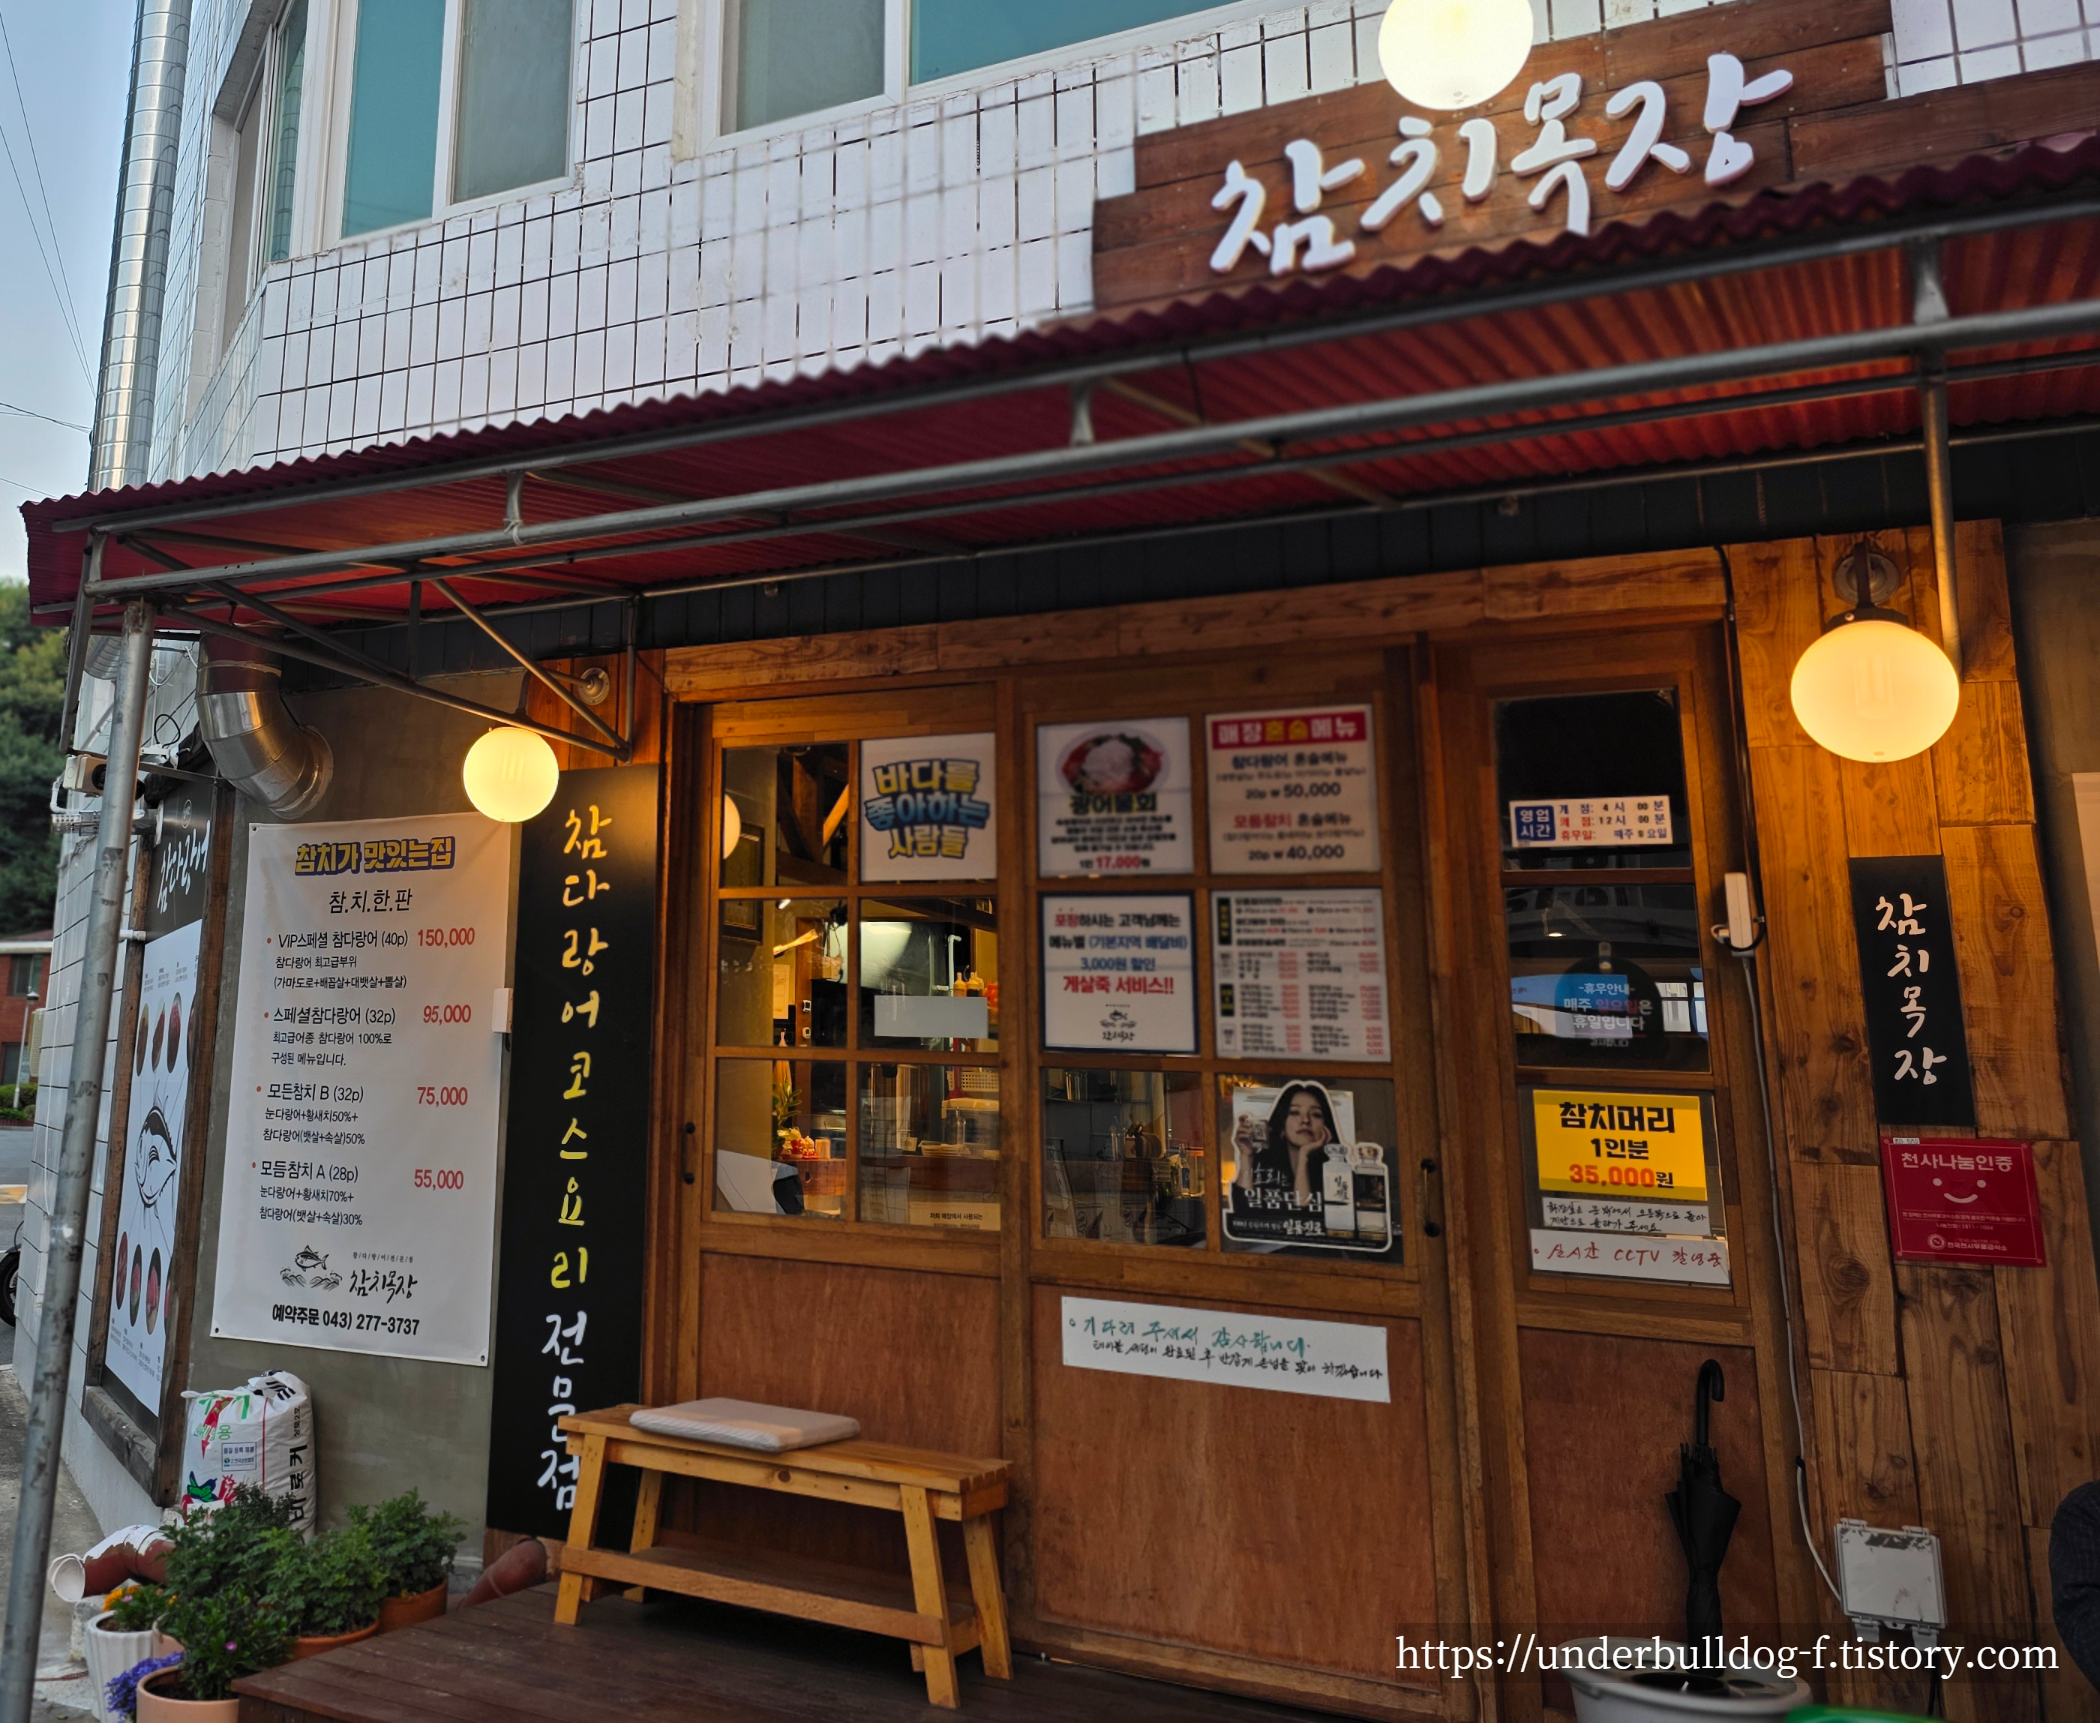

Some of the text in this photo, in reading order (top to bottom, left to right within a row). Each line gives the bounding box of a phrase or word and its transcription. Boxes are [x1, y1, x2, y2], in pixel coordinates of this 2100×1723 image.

[1210, 52, 1793, 276] 참치목장
[873, 758, 980, 795] 바다를
[864, 792, 990, 831] 좋아하는
[1520, 808, 1550, 822] 영업
[888, 824, 968, 859] 사람들
[1520, 824, 1551, 838] 시간
[295, 836, 455, 876] 참치가 맛있는집
[329, 888, 413, 914] 참.치.한.판
[1054, 913, 1181, 928] 포장하시는 고객님께는
[278, 927, 475, 949] VIP스페셜 참다랑어 (40p) 150,000
[1049, 936, 1188, 949] 메뉴별 (기본지역 배달비)
[275, 955, 357, 970] 참다랑어 최고급부위
[1080, 957, 1156, 972] 3,000원 할인
[1063, 976, 1175, 995] 게살죽 서비스!!
[1875, 893, 1947, 1085] 참치목장
[273, 1004, 472, 1025] 스페셜참다랑어 (32p) 95,000
[1564, 998, 1591, 1012] 매주
[1573, 1015, 1646, 1031] 휴일입니다
[272, 1031, 392, 1045] 최고급어종 참다랑어 100%로
[271, 1052, 347, 1067] 구성된 메뉴입니다.
[267, 1083, 468, 1107] 모든참치 B (32p) 75,000
[1559, 1101, 1676, 1133] 참치머리
[1590, 1138, 1649, 1160] 1인분
[1901, 1152, 2013, 1172] 천사나눔인증
[260, 1160, 464, 1191] 모듬참치 A (28p) 55,000
[1244, 1187, 1322, 1212] 일품단심
[1547, 1242, 1600, 1260] 실시간
[1614, 1249, 1660, 1266] CCTV
[349, 1269, 418, 1304] 참치목장
[272, 1303, 420, 1335] 예약주문 043) 277-3737
[1082, 1316, 1136, 1336] 기다려
[1093, 1339, 1124, 1354] 테이블
[1199, 1349, 1215, 1369] 후
